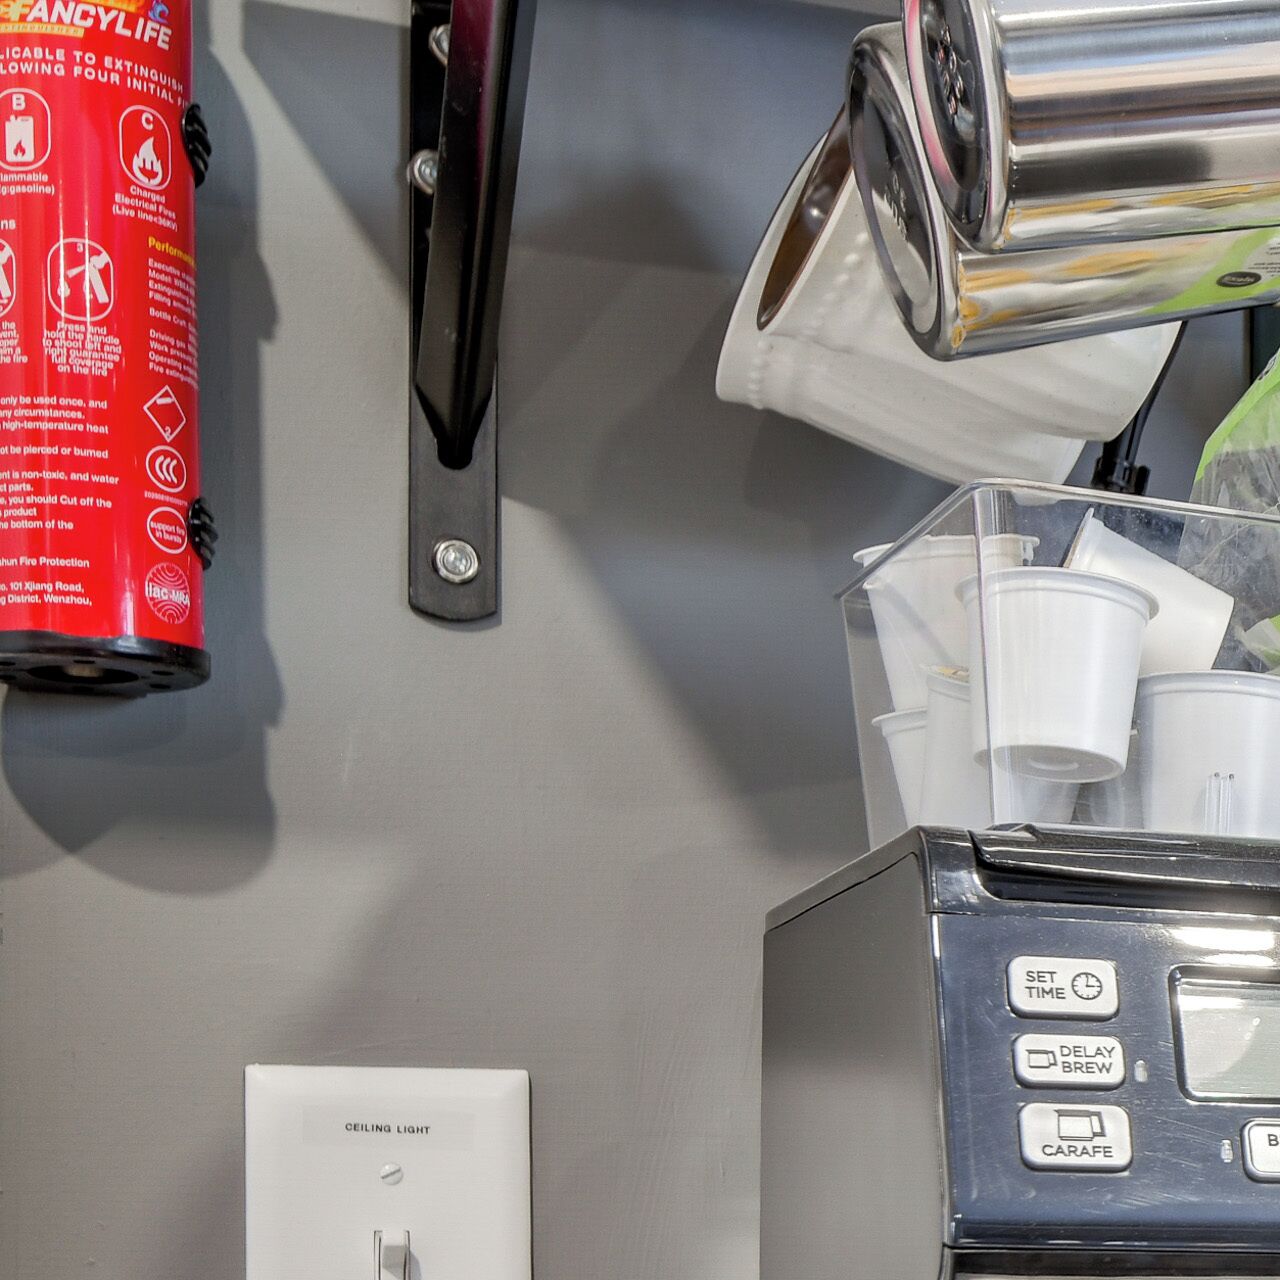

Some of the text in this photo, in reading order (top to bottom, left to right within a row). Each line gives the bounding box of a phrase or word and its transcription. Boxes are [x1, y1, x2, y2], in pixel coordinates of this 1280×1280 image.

[73, 51, 96, 65] TO
[104, 56, 183, 93] EXTINGUISH
[73, 65, 120, 85] FOUR
[127, 77, 174, 104] INITIAL
[12, 93, 26, 111] B
[141, 112, 154, 131] C
[130, 186, 166, 204] Charged
[115, 193, 157, 213] Electrical
[113, 204, 135, 218] (Live
[57, 321, 86, 332] Press
[44, 329, 120, 345] hold the handle
[42, 338, 122, 354] to shoot left and
[44, 347, 120, 362] right guarantee
[51, 354, 114, 370] full coverage
[57, 364, 108, 377] on the fire
[1, 395, 107, 409] only be used and
[2, 420, 109, 434] high-temperature heat
[10, 445, 21, 454] be
[23, 445, 58, 456] pierced
[60, 446, 72, 455] or
[12, 470, 20, 479] is
[21, 470, 68, 480] non-toxic,
[70, 472, 89, 481] and
[91, 474, 119, 485] water
[8, 482, 34, 493] parts.
[8, 496, 24, 506] you
[26, 494, 58, 504] should
[60, 494, 78, 506] Cut
[80, 497, 94, 506] off
[96, 498, 112, 508] the
[3, 507, 37, 518] product
[10, 519, 74, 530] bottom of the
[19, 556, 90, 568] Fire Protection
[10, 582, 22, 590] 101
[55, 581, 85, 593] Road,
[7, 594, 42, 604] District,
[43, 593, 92, 606] Wenzhou,
[1026, 970, 1057, 983] SET
[1025, 986, 1066, 999] TIME
[1059, 1045, 1115, 1059] DELAY
[1061, 1061, 1113, 1074] BREW
[345, 1122, 431, 1134] CEILING LIGHT
[1042, 1144, 1113, 1158] CARAFE
